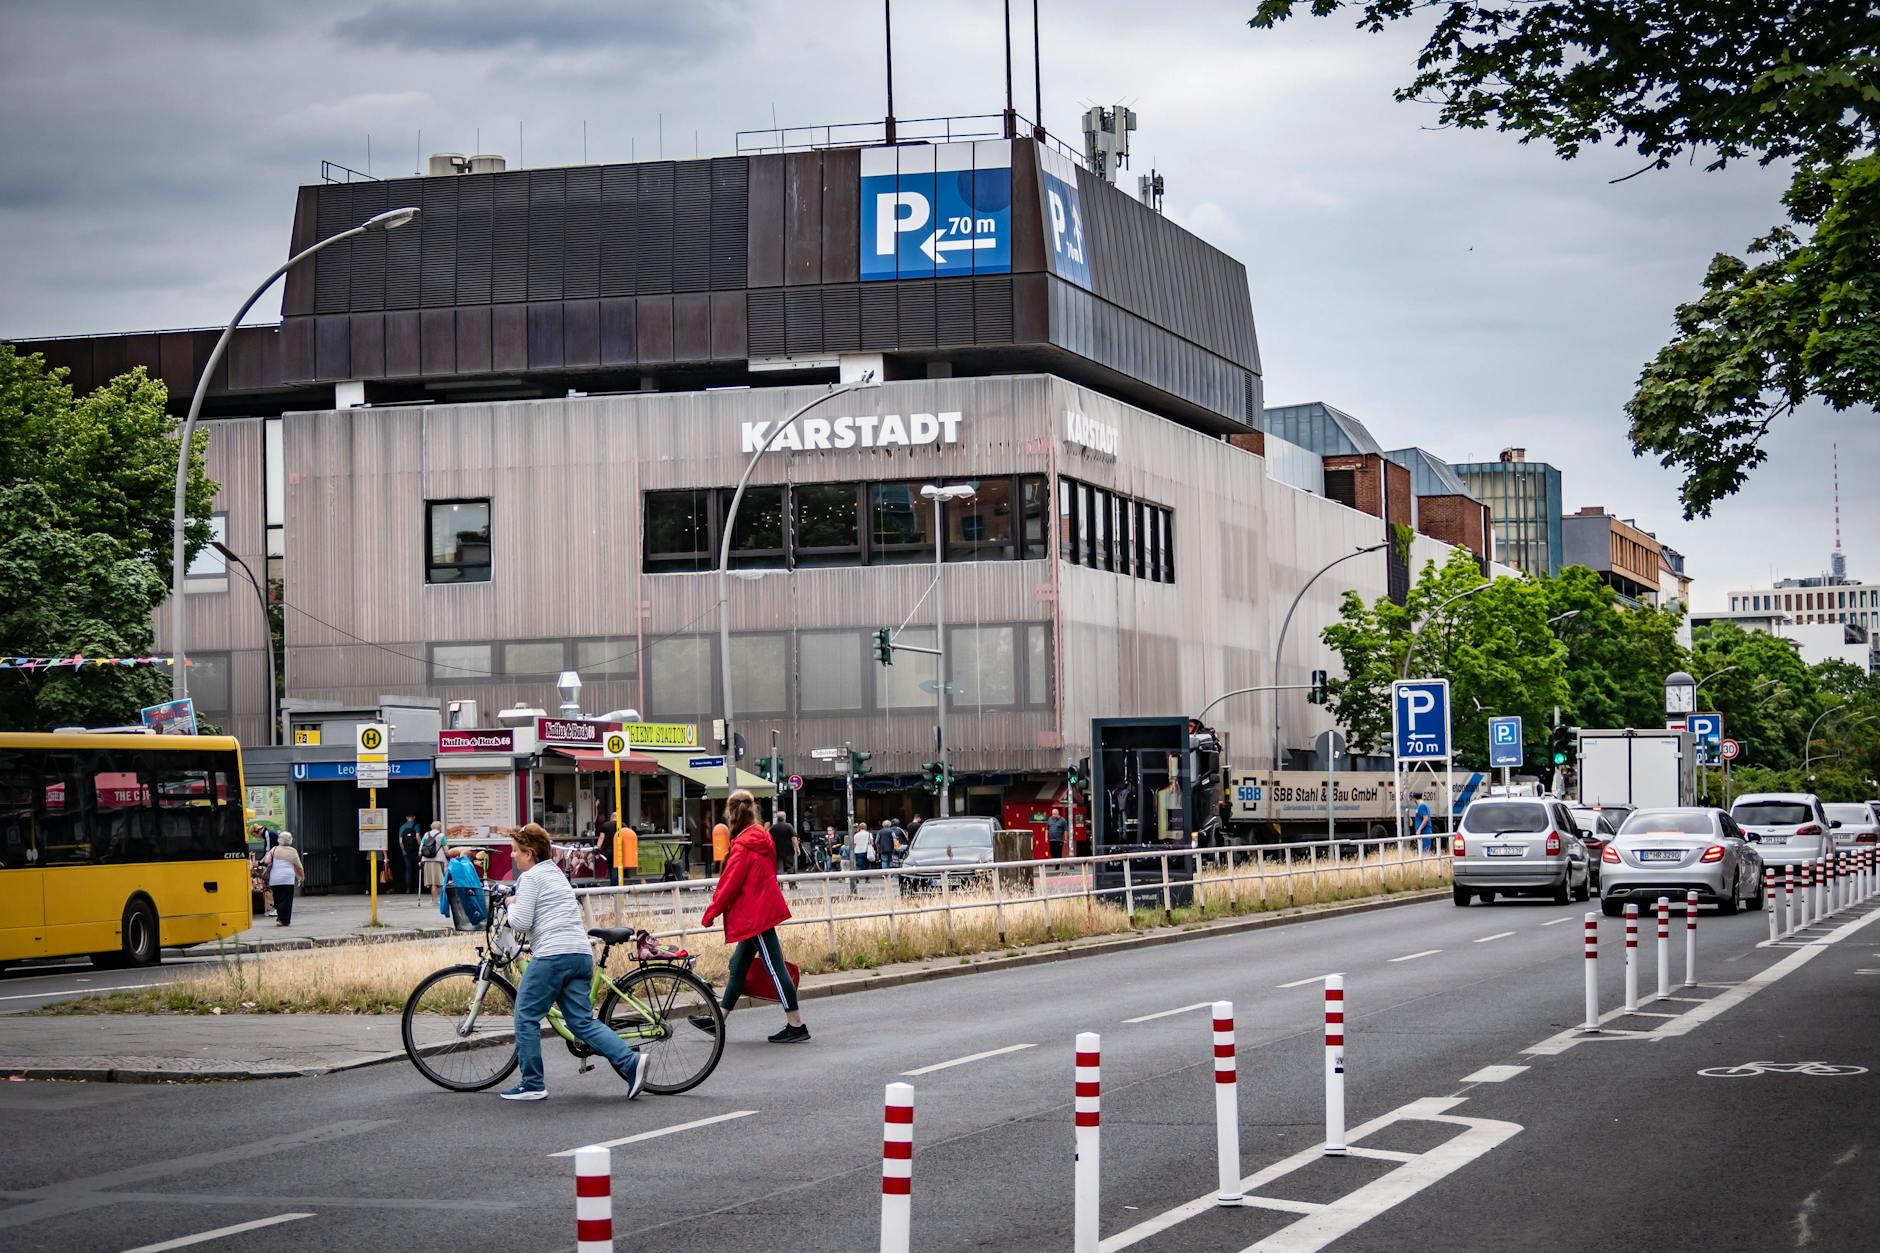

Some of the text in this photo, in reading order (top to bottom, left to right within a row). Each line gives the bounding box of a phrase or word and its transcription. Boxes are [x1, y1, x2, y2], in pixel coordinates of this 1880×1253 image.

[877, 191, 930, 256] P
[949, 216, 996, 235] 70 m
[1048, 188, 1066, 253] P
[741, 411, 963, 453] KARSTADT
[1067, 409, 1118, 456] KARSTADT
[1407, 690, 1435, 731] P
[656, 726, 686, 744] STATION
[1498, 725, 1510, 742] P
[1694, 719, 1712, 743] P
[442, 737, 469, 747] Kaffee
[470, 737, 478, 746] &
[478, 736, 500, 746] Back
[1407, 741, 1439, 753] 70 m
[1723, 744, 1735, 754] 30
[294, 764, 306, 779] U
[338, 764, 400, 777] Leoatz
[114, 790, 131, 802] THE
[1238, 786, 1262, 801] SBB
[1273, 787, 1293, 802] SBB
[1295, 787, 1318, 802] Stahl
[1320, 787, 1328, 802] &
[1351, 787, 1378, 802] GmbH
